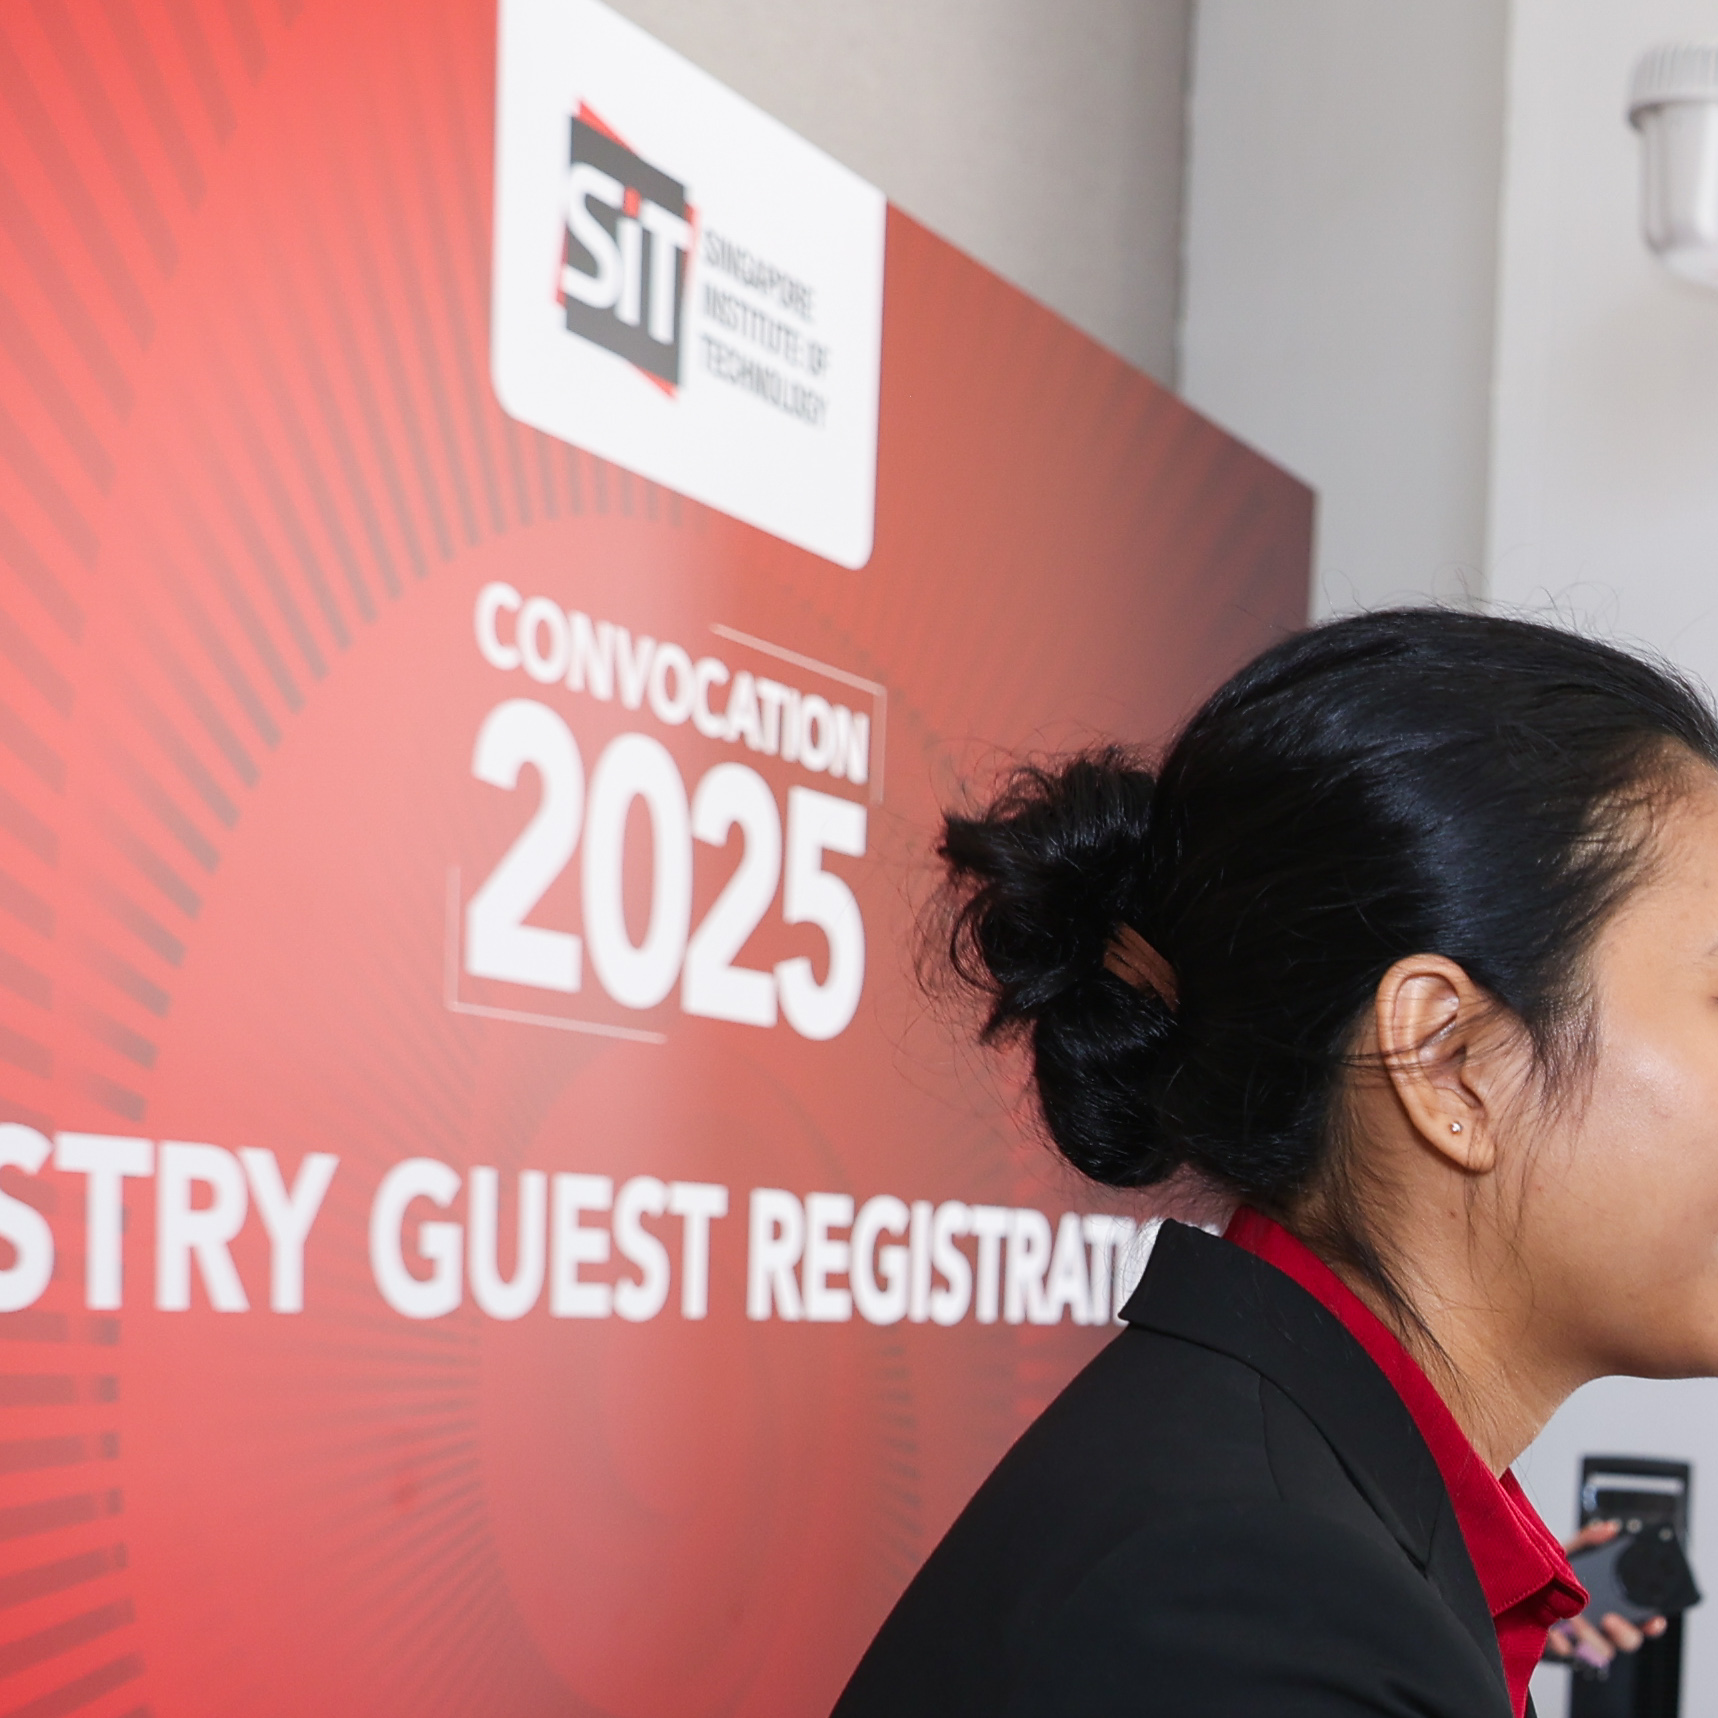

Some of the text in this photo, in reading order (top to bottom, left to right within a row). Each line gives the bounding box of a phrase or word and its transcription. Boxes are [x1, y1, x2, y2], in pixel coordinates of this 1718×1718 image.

[703, 227, 815, 327] SINGAPORE
[703, 282, 829, 379] INSTITUTE OF
[701, 332, 828, 430] TECHNOLOGY
[474, 580, 870, 785] CONVOCATION
[464, 698, 869, 1041] 2025
[367, 1157, 729, 1322] GUEST
